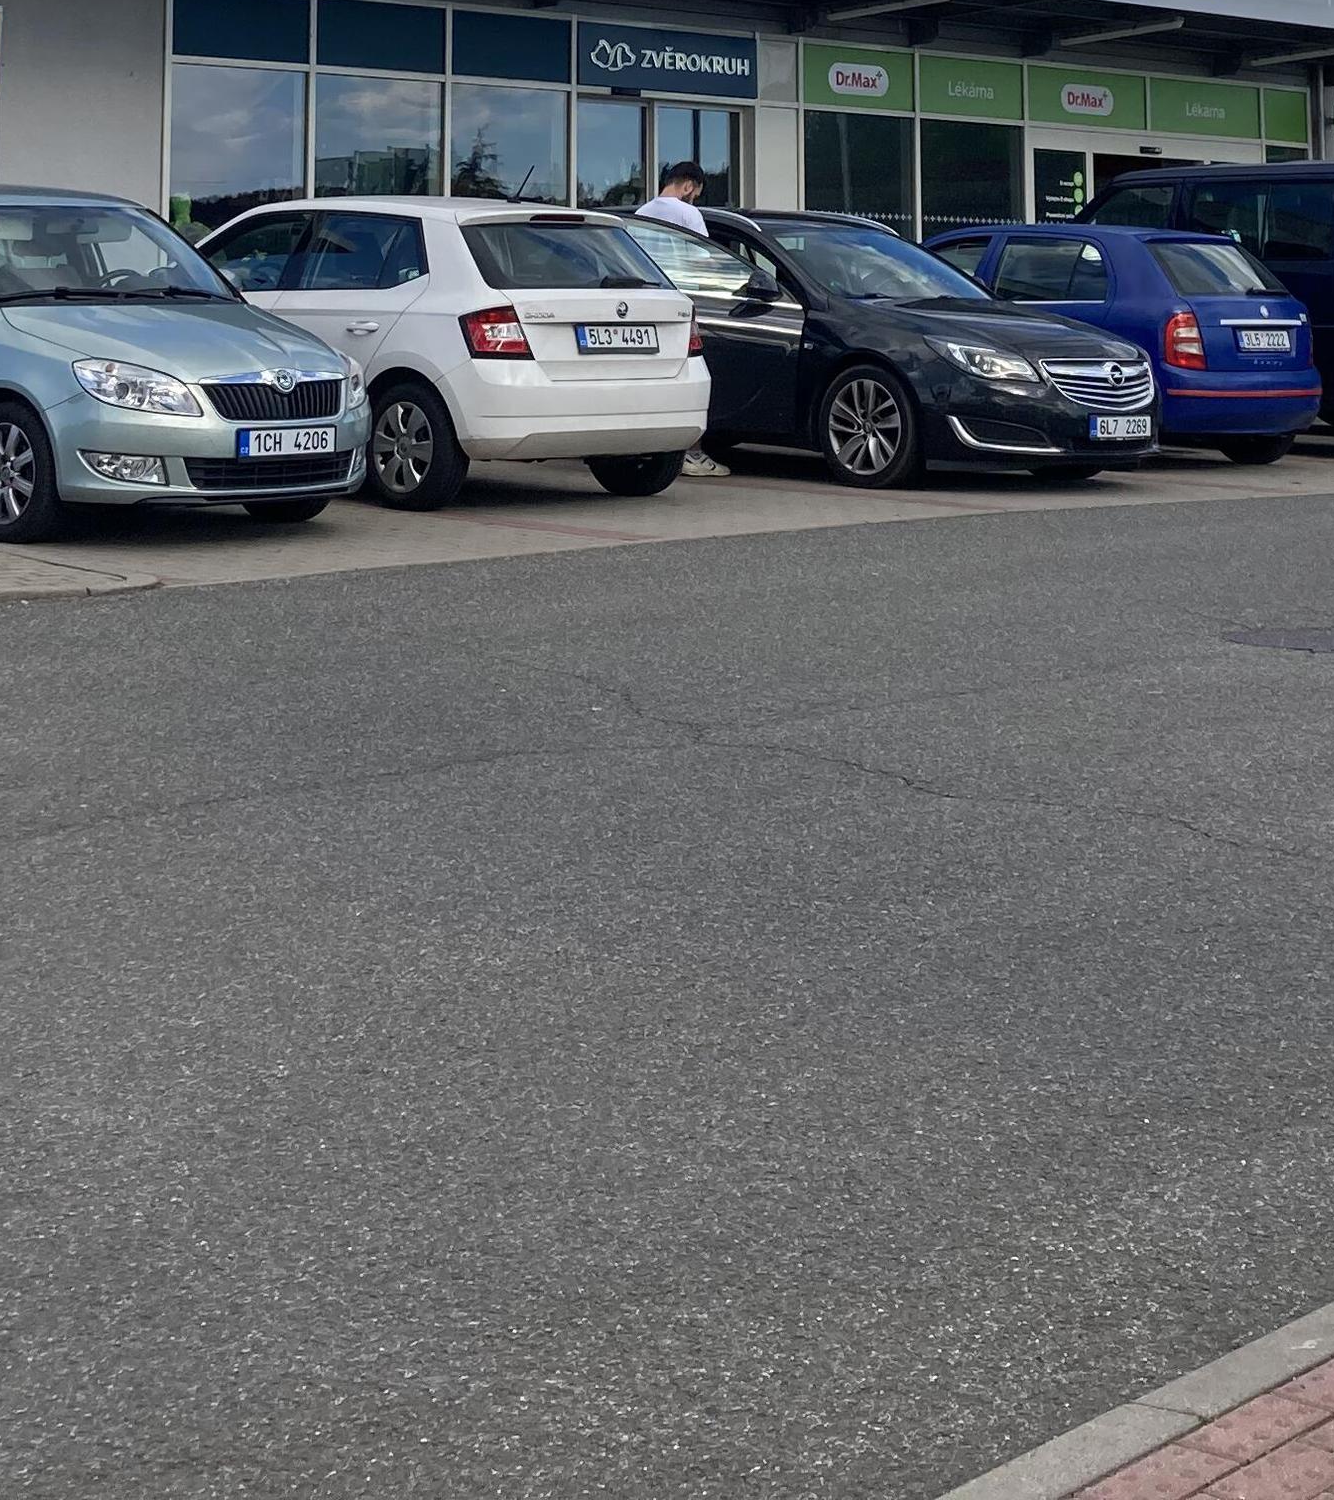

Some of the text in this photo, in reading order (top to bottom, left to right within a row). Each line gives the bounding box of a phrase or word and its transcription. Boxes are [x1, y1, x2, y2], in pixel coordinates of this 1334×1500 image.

[640, 46, 750, 76] ZVĚROKRUH
[835, 70, 878, 89] Dr.Max
[948, 80, 995, 100] Lékárna
[1067, 91, 1104, 109] Dr.Max
[588, 328, 652, 346] 5L3 4491
[1243, 332, 1287, 347] 3L5 2222
[1099, 418, 1148, 436] 6L7 2269
[254, 431, 283, 453] 1CH
[293, 430, 329, 452] 4206
